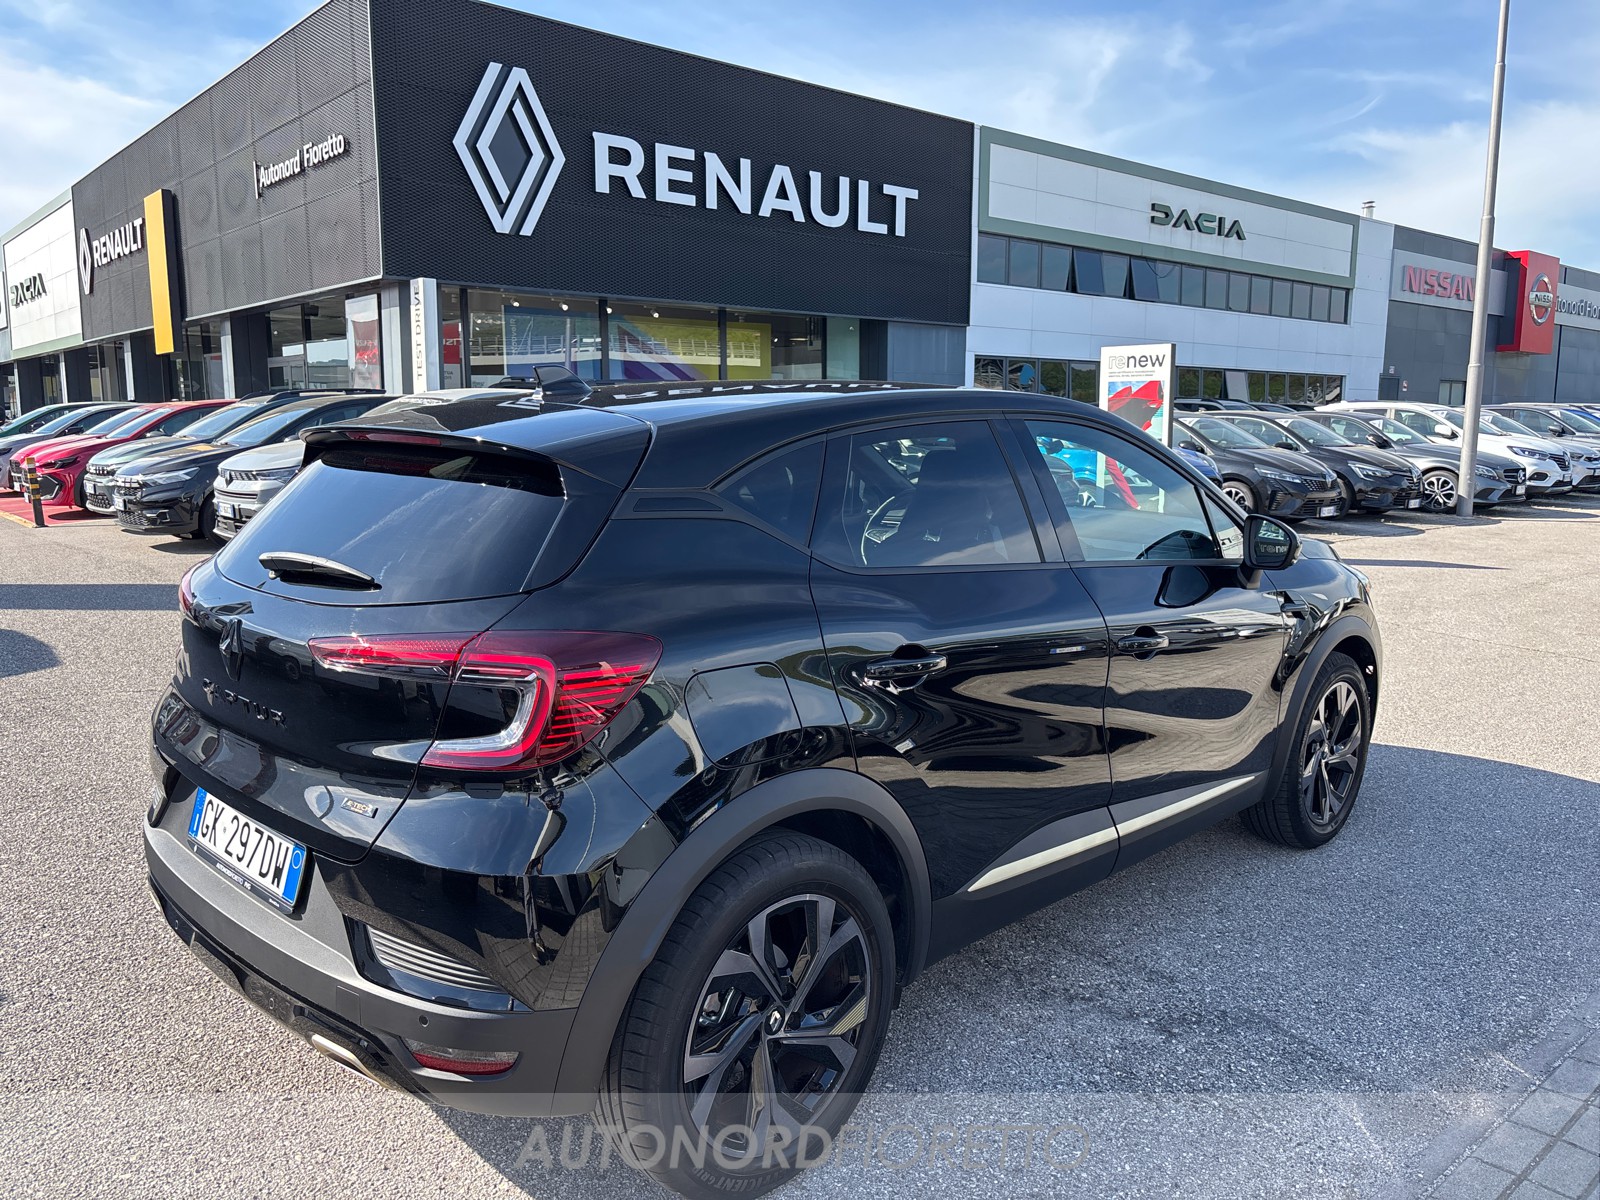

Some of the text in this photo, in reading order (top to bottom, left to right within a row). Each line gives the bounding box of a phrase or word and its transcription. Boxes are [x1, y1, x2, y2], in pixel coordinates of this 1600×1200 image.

[260, 133, 345, 188] Autonord Fioretto
[592, 131, 919, 237] RENAULT
[92, 217, 143, 268] RENAULT
[1150, 203, 1246, 240] DACIA
[10, 273, 47, 306] DACIA
[1555, 297, 1585, 316] tonord
[413, 285, 424, 380] TEST DRIVE
[1108, 354, 1166, 369] renew
[201, 799, 225, 847] GK
[224, 814, 290, 890] 297DW
